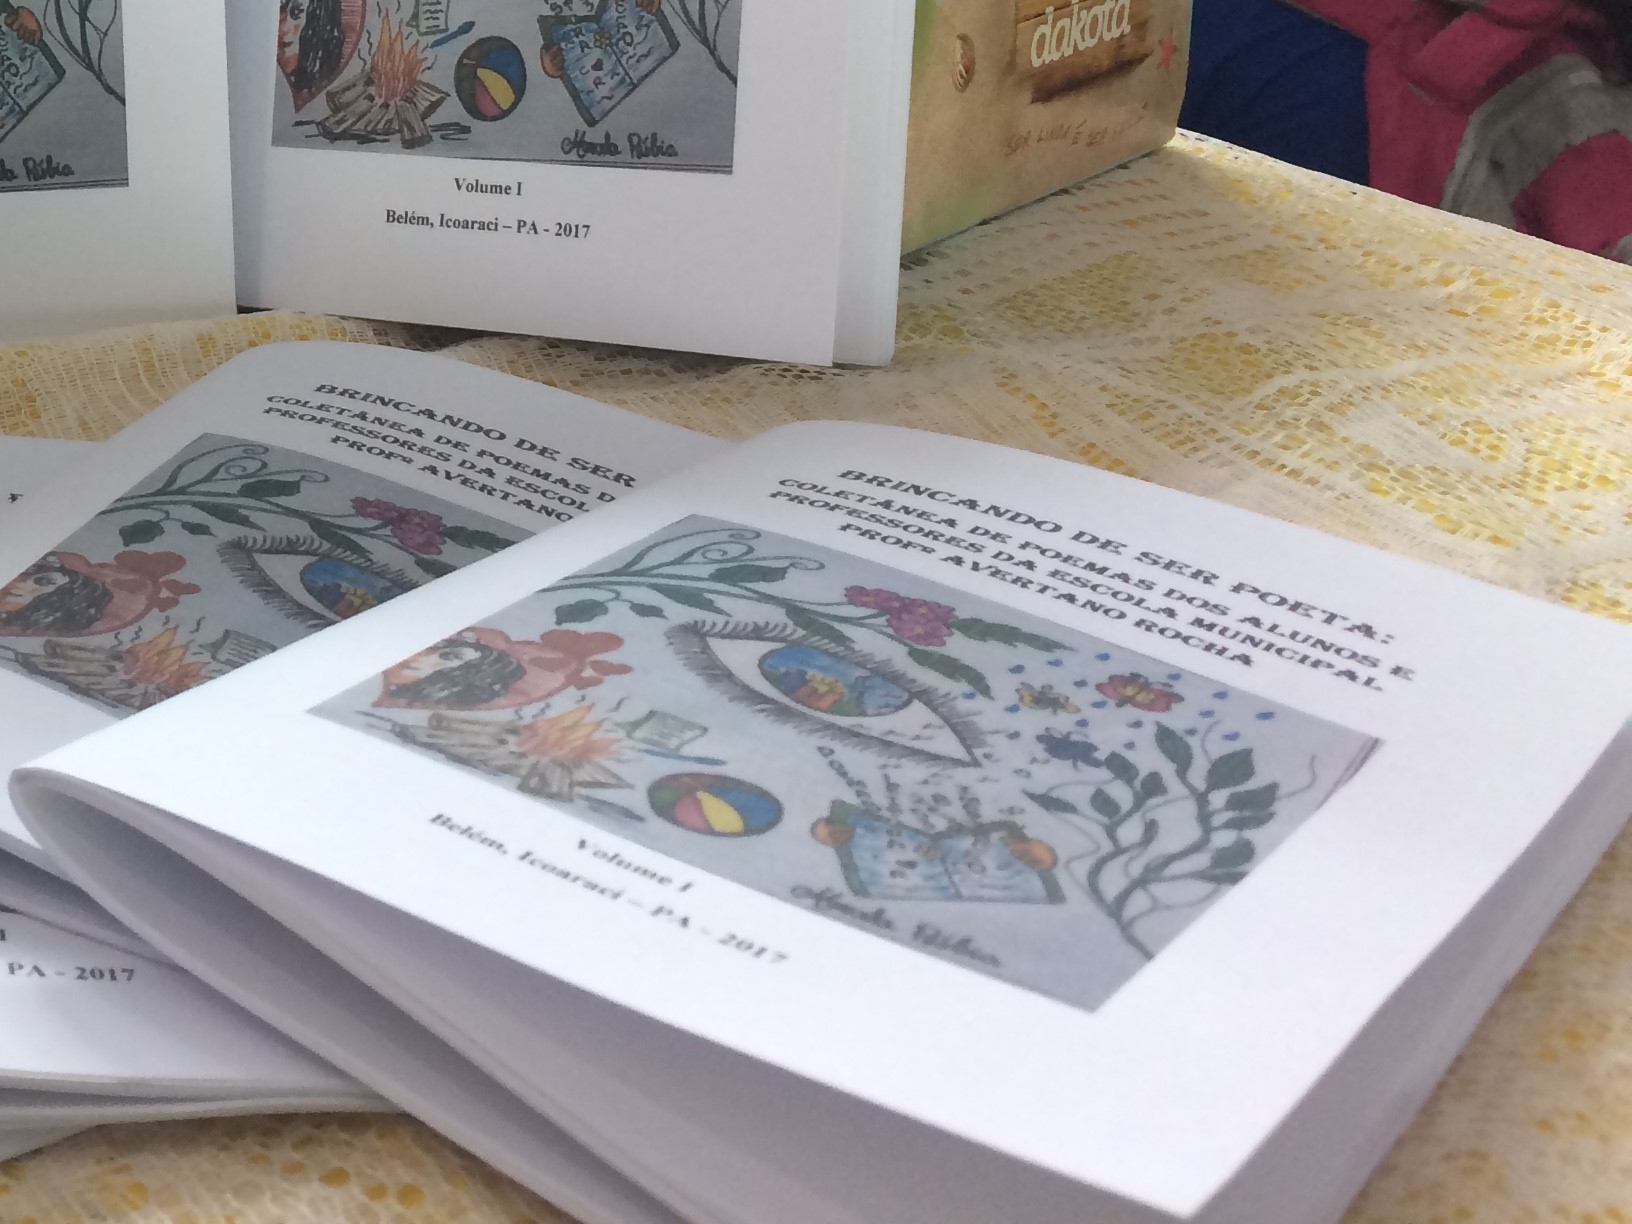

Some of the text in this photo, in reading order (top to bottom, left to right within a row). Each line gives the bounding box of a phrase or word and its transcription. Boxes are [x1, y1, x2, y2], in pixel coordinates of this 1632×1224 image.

[385, 209, 591, 238] Belém, Icoaraci PA 2017
[454, 178, 522, 196] Volume I
[262, 407, 496, 479] PROFESSORES DA
[267, 396, 591, 494] COLETÂNEA DE POEMAS
[313, 384, 637, 488] BRINCANDO DE SER
[768, 491, 1382, 691] PROFESSORES DA ESCOLA MUNICIPAL
[778, 479, 1382, 668] COLETÂNEA DE POEMAS DOS ALUNOS
[837, 469, 1396, 644] BRINCANDO DE SER POETA:
[940, 554, 1254, 668] AVERTANO ROCHA
[8, 962, 46, 978] PA
[74, 966, 135, 982] 2017
